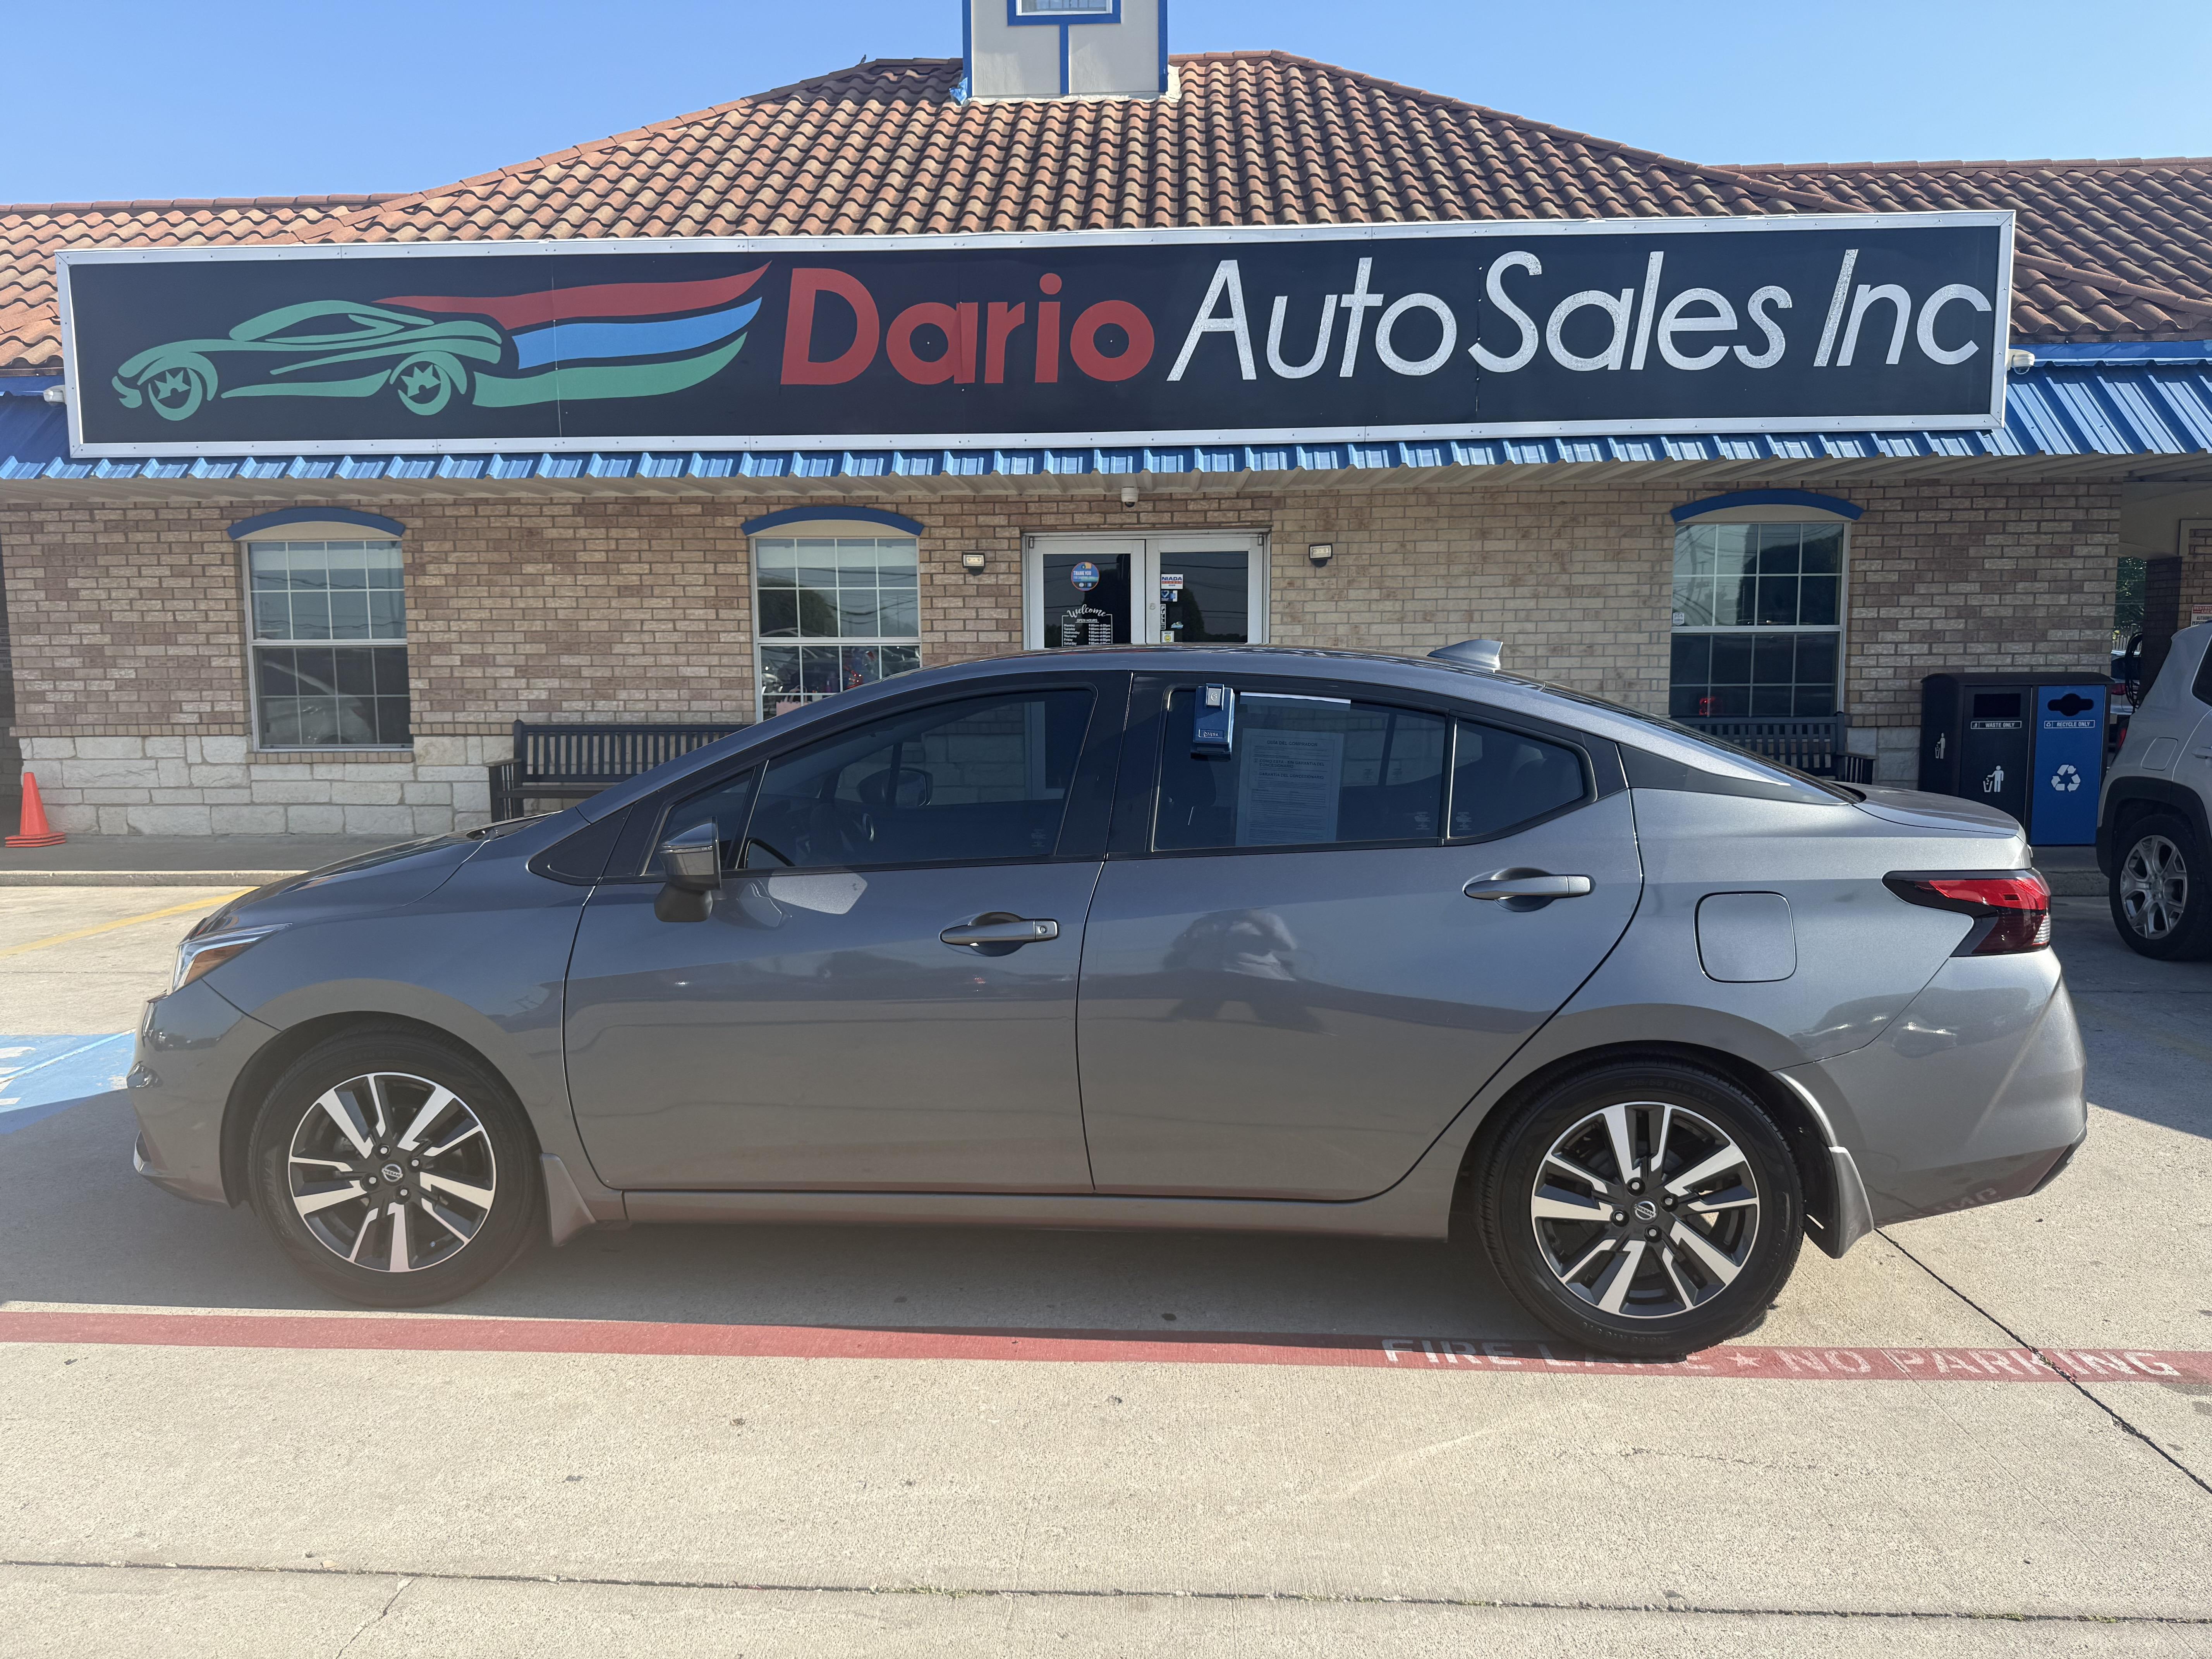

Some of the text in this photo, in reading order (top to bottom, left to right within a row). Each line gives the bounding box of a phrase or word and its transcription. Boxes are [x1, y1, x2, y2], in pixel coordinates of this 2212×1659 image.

[780, 249, 1992, 385] Dario Auto Sales Inc
[1066, 604, 1107, 618] Welcome
[1637, 1206, 1654, 1216] NISSAN
[1382, 1339, 1522, 1365] FIRE
[1773, 1349, 1871, 1373] NO
[1881, 1349, 2181, 1376] PARKING
